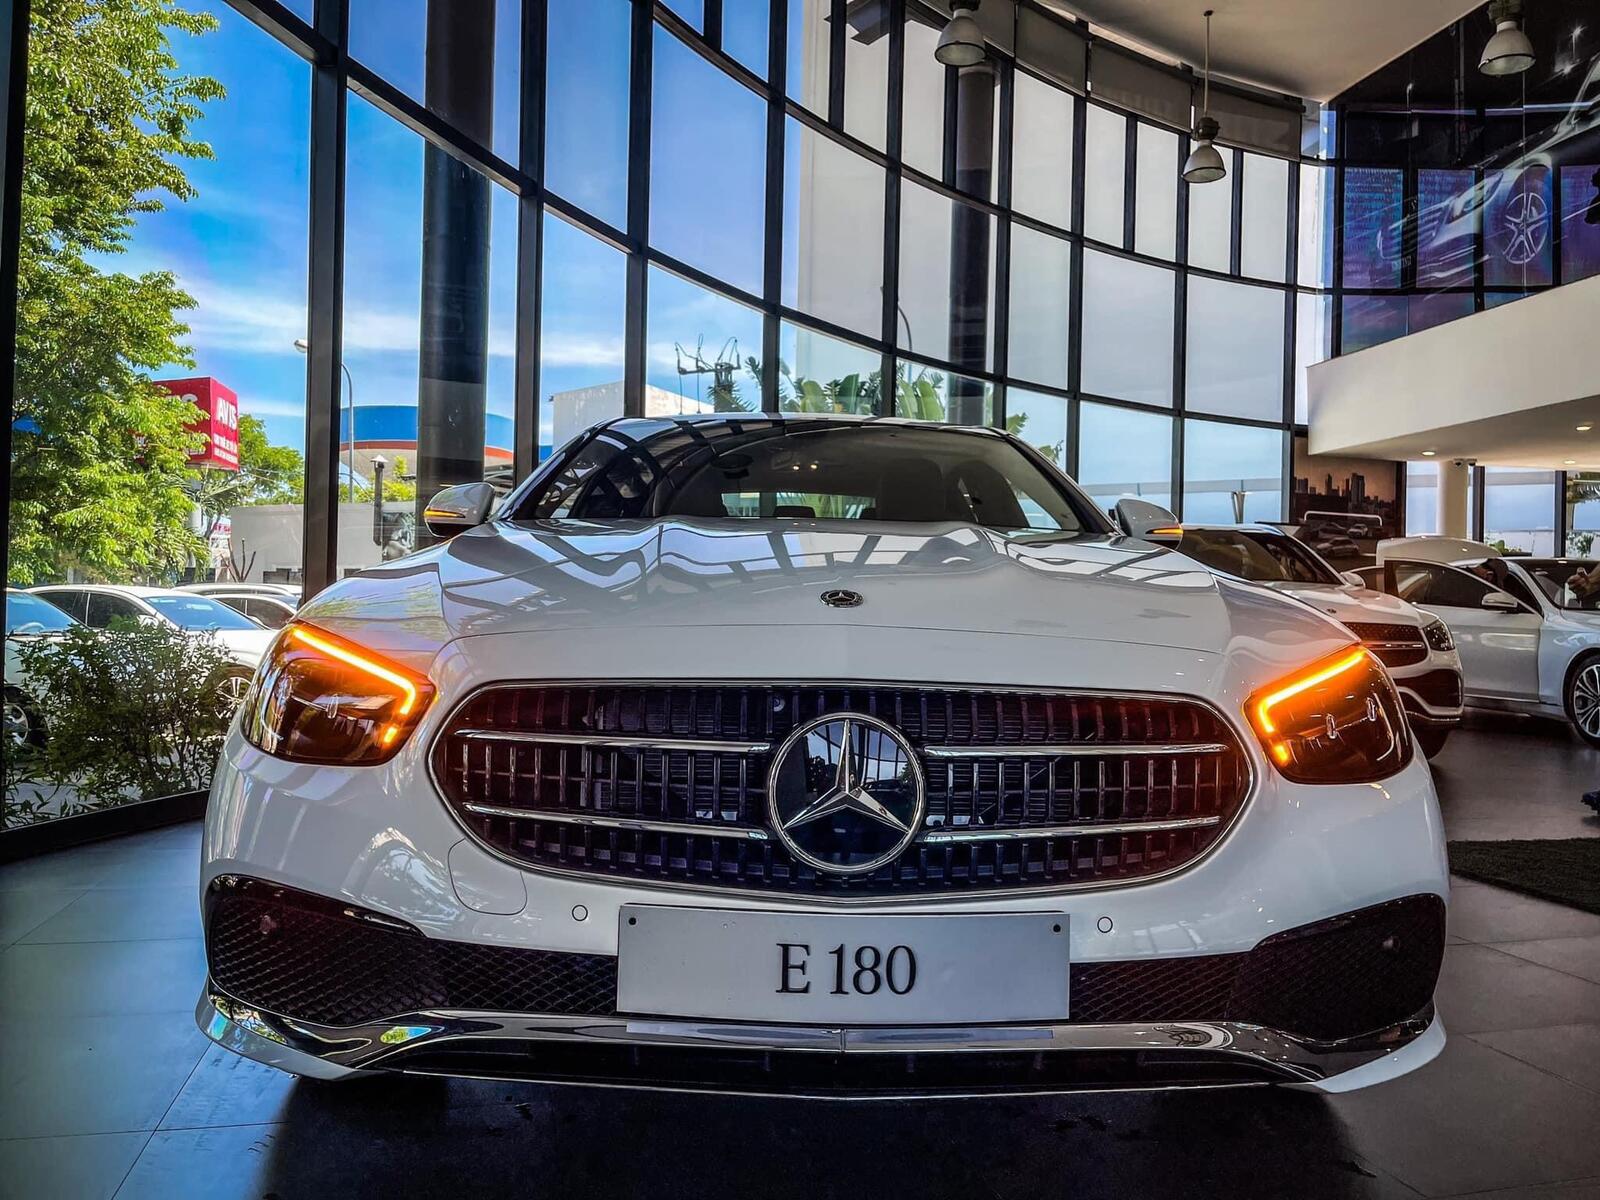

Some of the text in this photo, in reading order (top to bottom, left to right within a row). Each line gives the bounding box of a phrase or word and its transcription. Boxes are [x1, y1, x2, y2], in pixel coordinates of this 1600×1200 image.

[216, 397, 237, 431] AVIS
[776, 943, 917, 995] E 180
